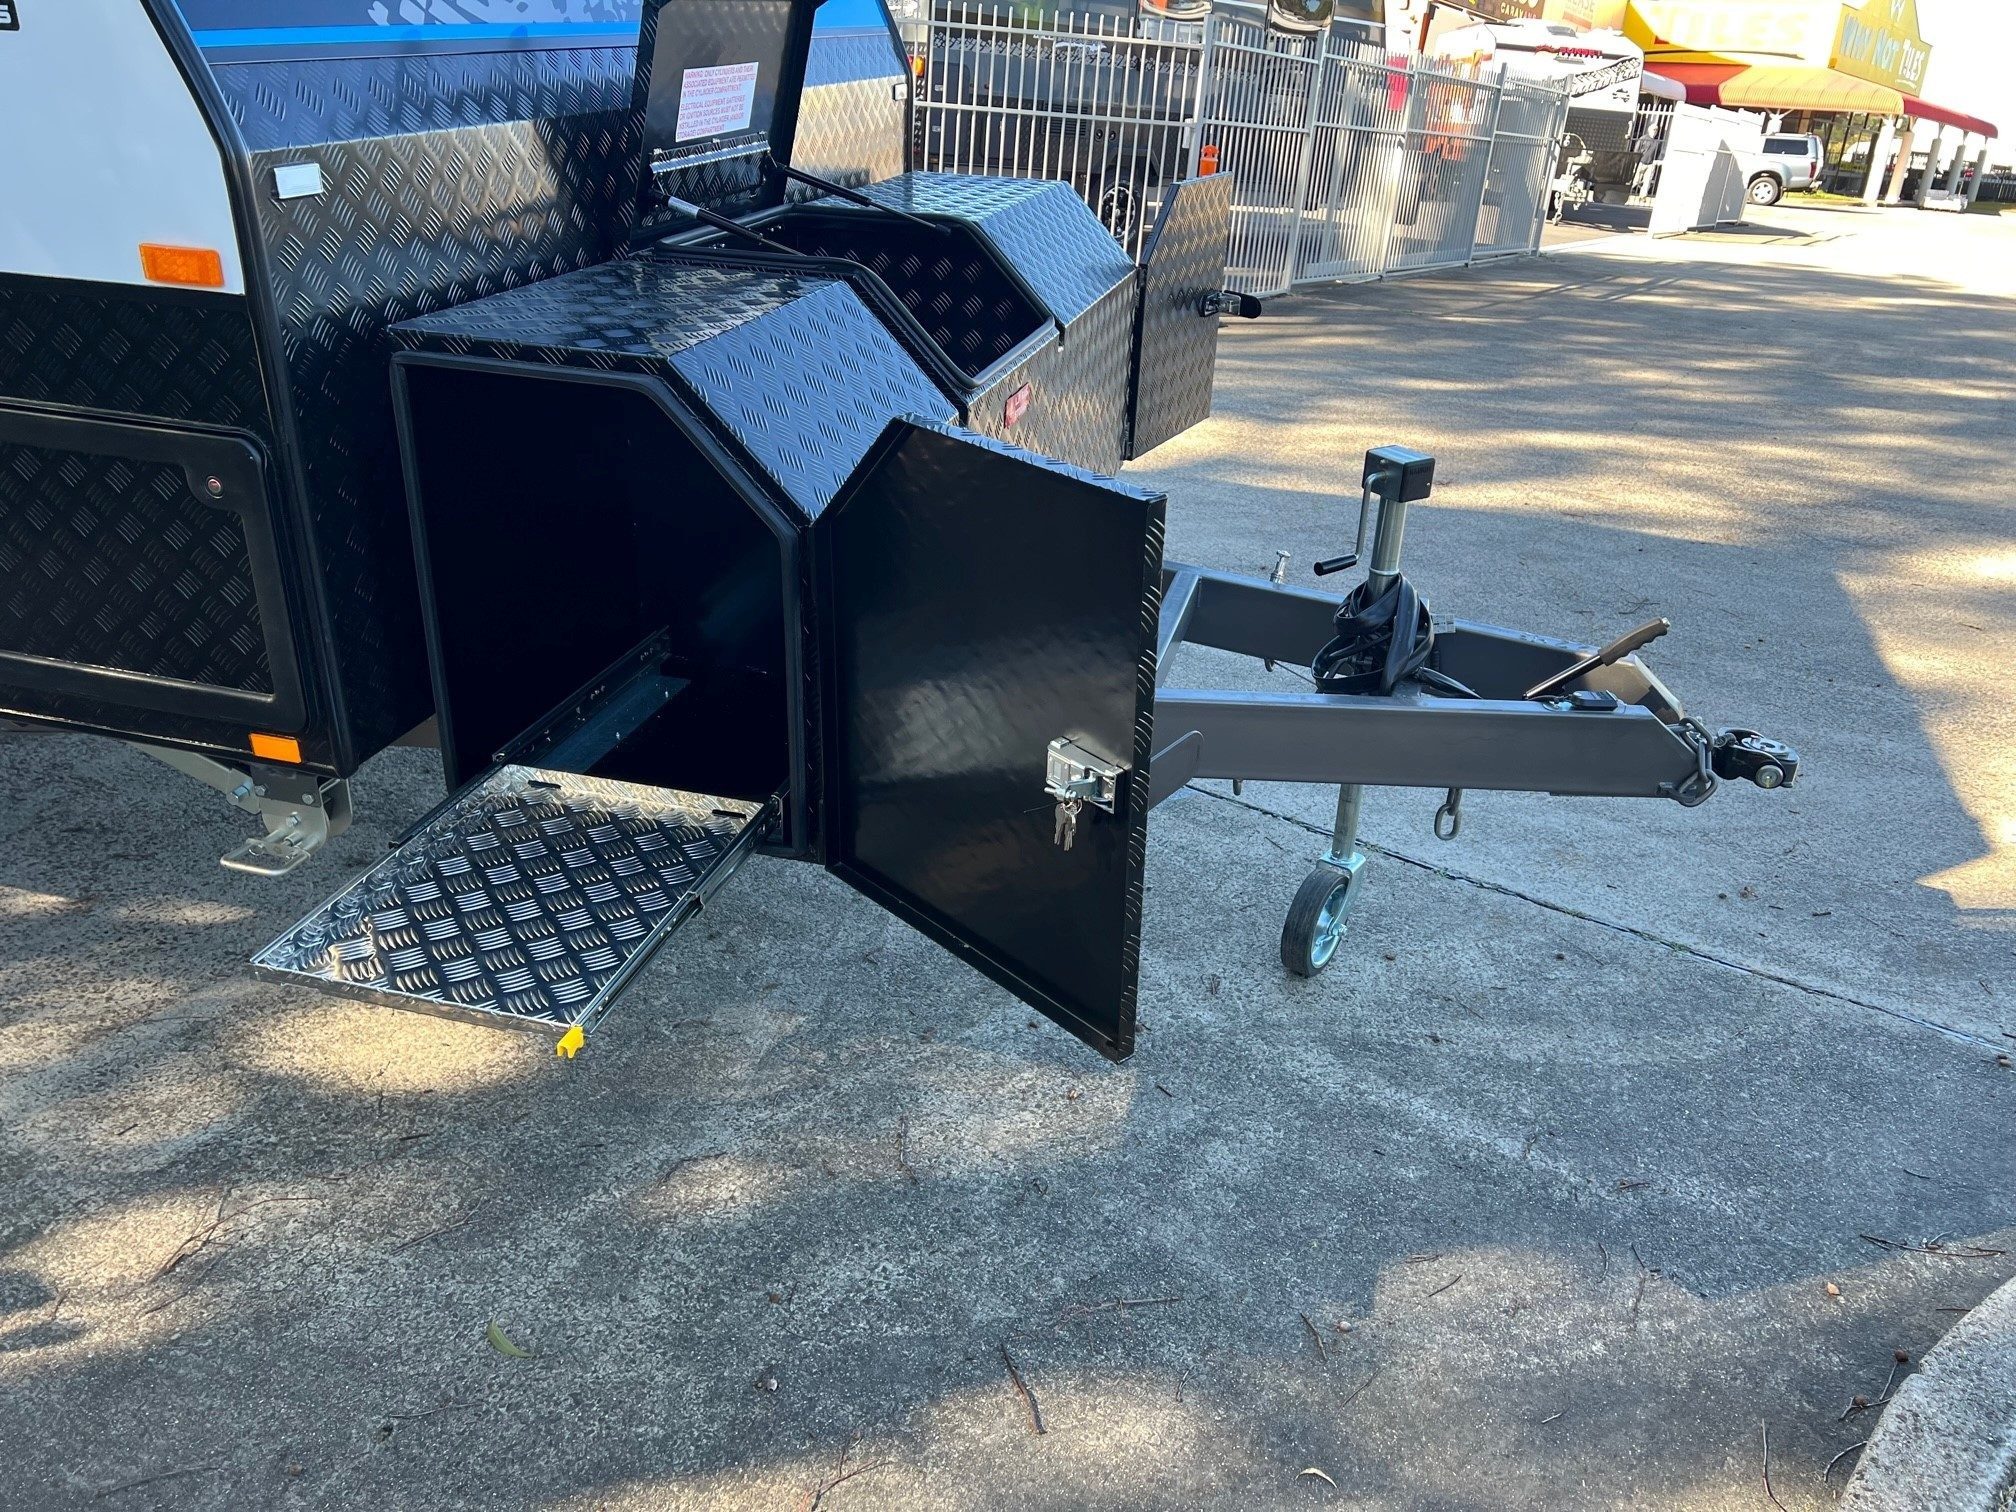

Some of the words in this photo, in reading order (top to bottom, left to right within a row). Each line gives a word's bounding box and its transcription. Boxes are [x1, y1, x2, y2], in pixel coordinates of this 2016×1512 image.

[1840, 13, 1874, 62] WHY
[1870, 27, 1900, 73] NOT
[1899, 38, 1926, 82] TILES
